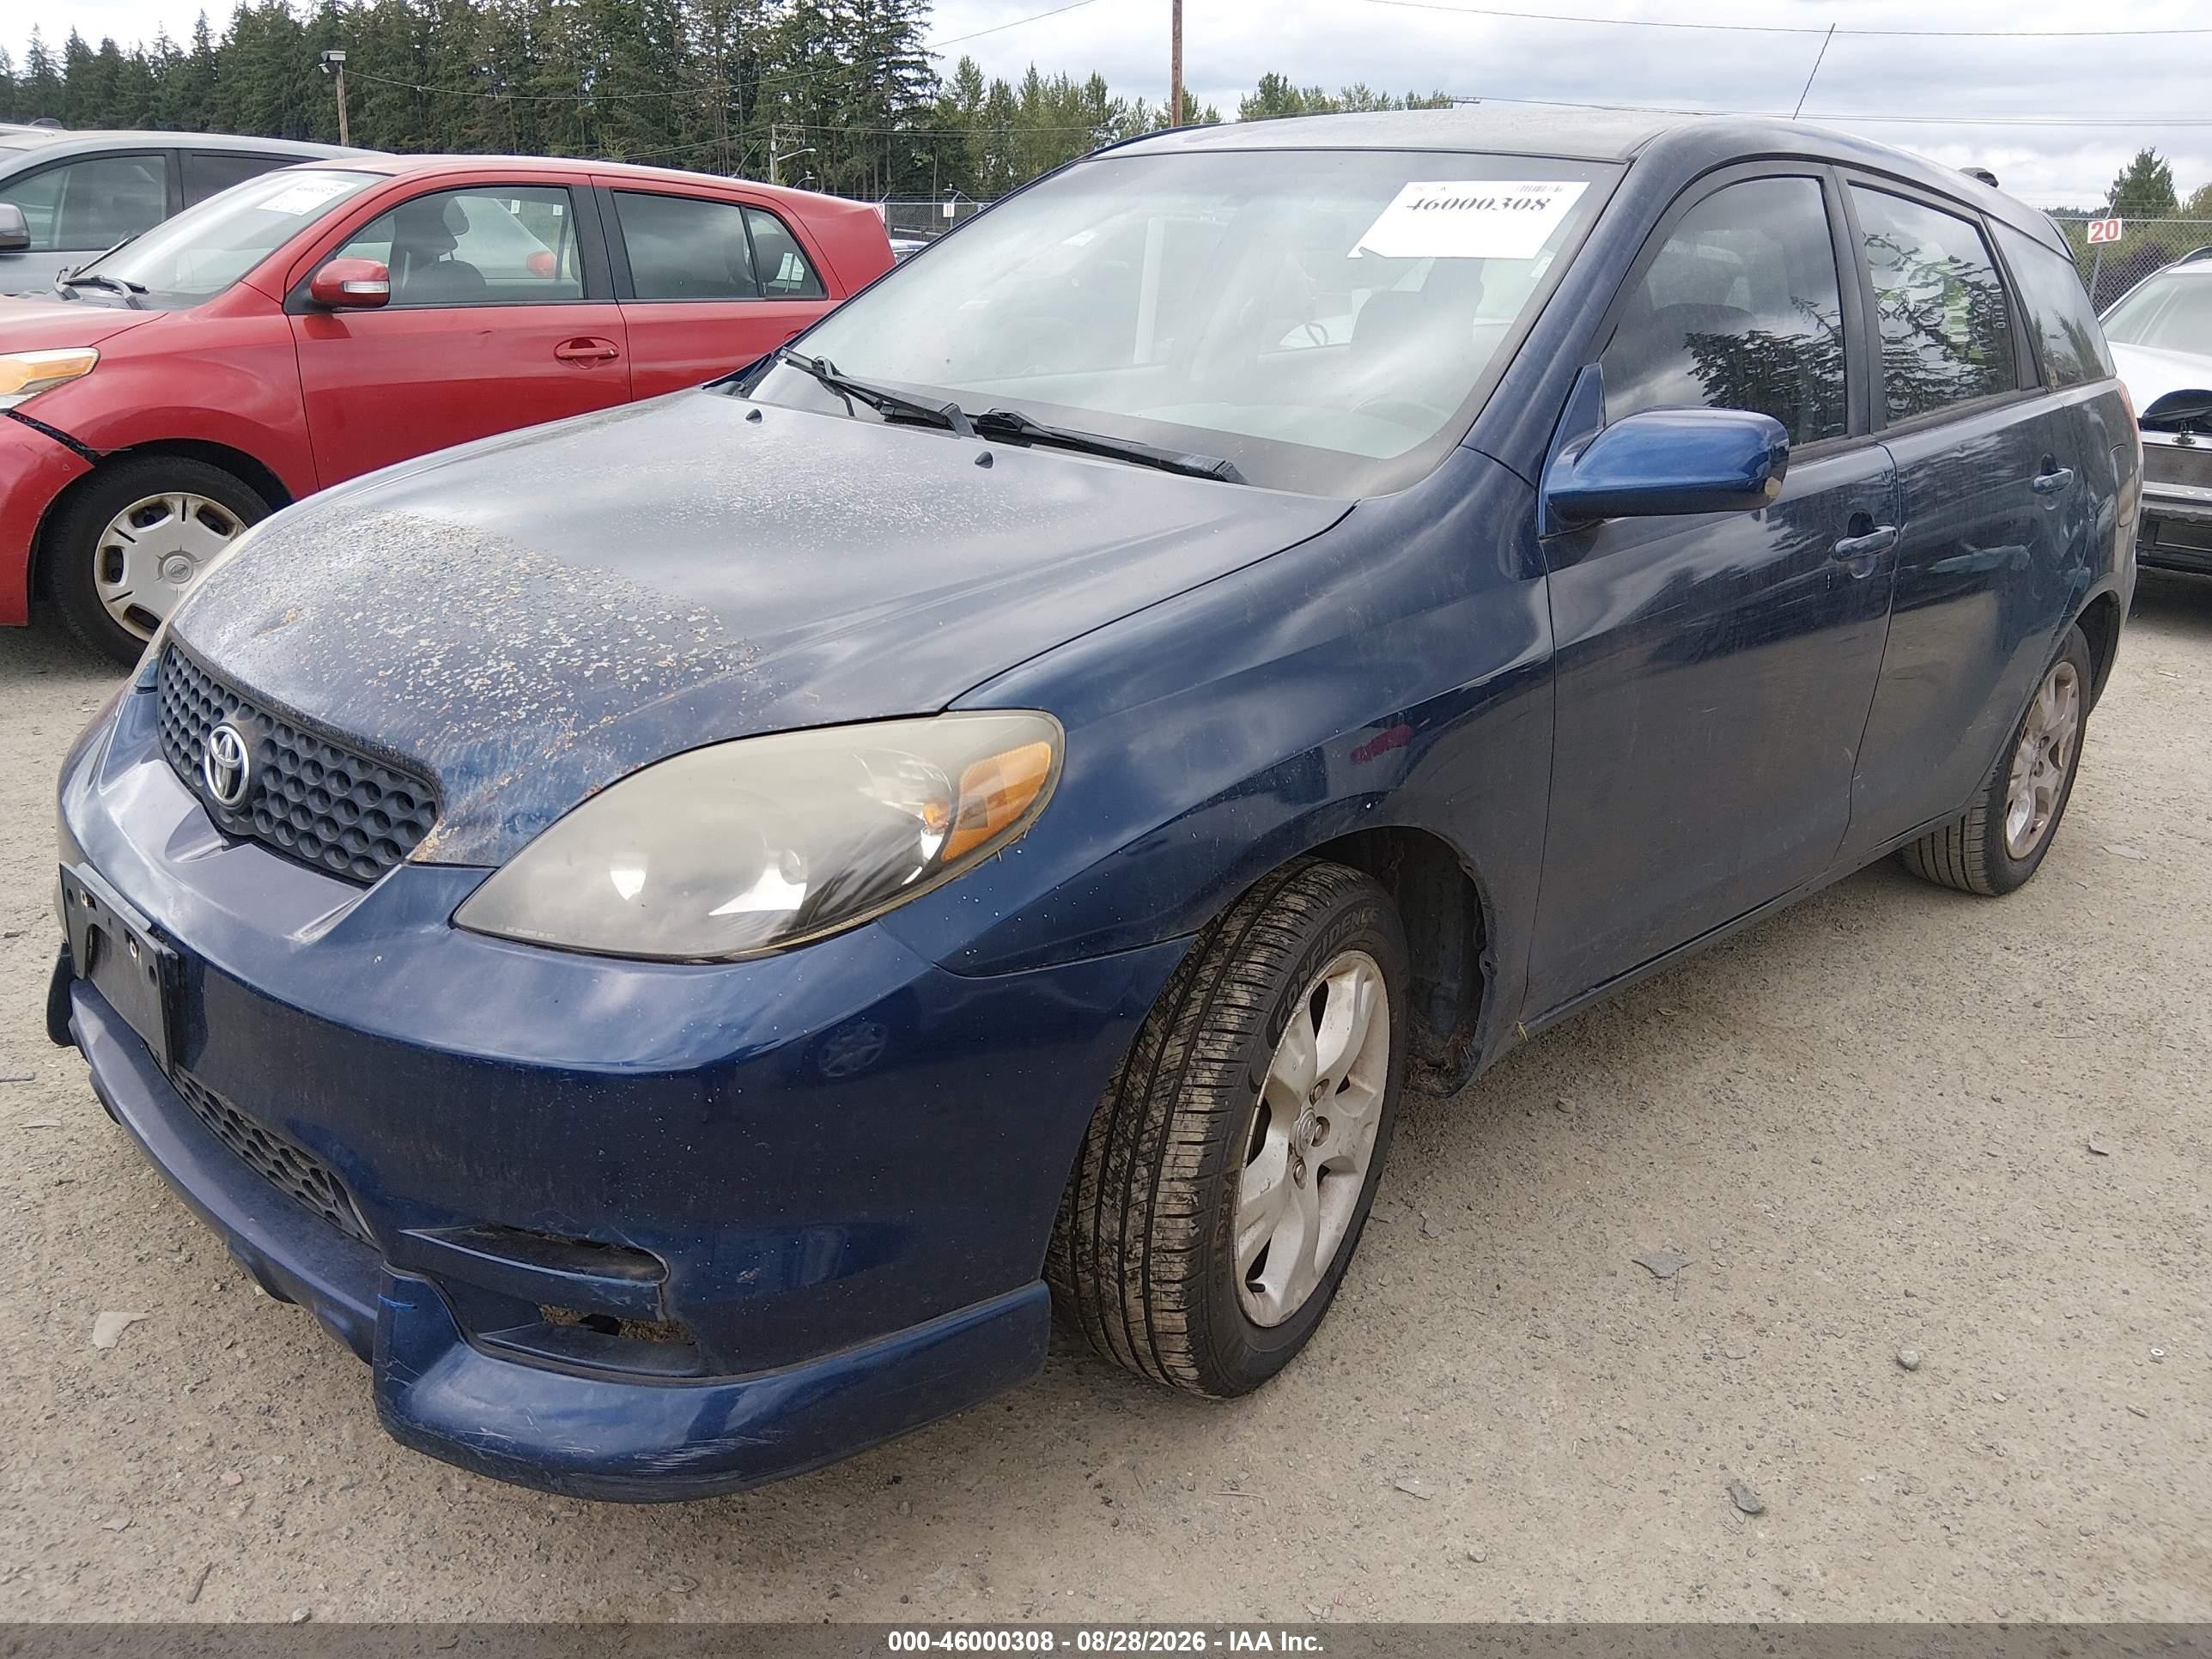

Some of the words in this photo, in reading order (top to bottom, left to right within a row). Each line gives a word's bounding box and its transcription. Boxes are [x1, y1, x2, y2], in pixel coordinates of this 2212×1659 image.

[1406, 197, 1552, 211] 46000308
[2090, 220, 2119, 242] 20
[1276, 906, 1379, 1034] CONFIDENCE
